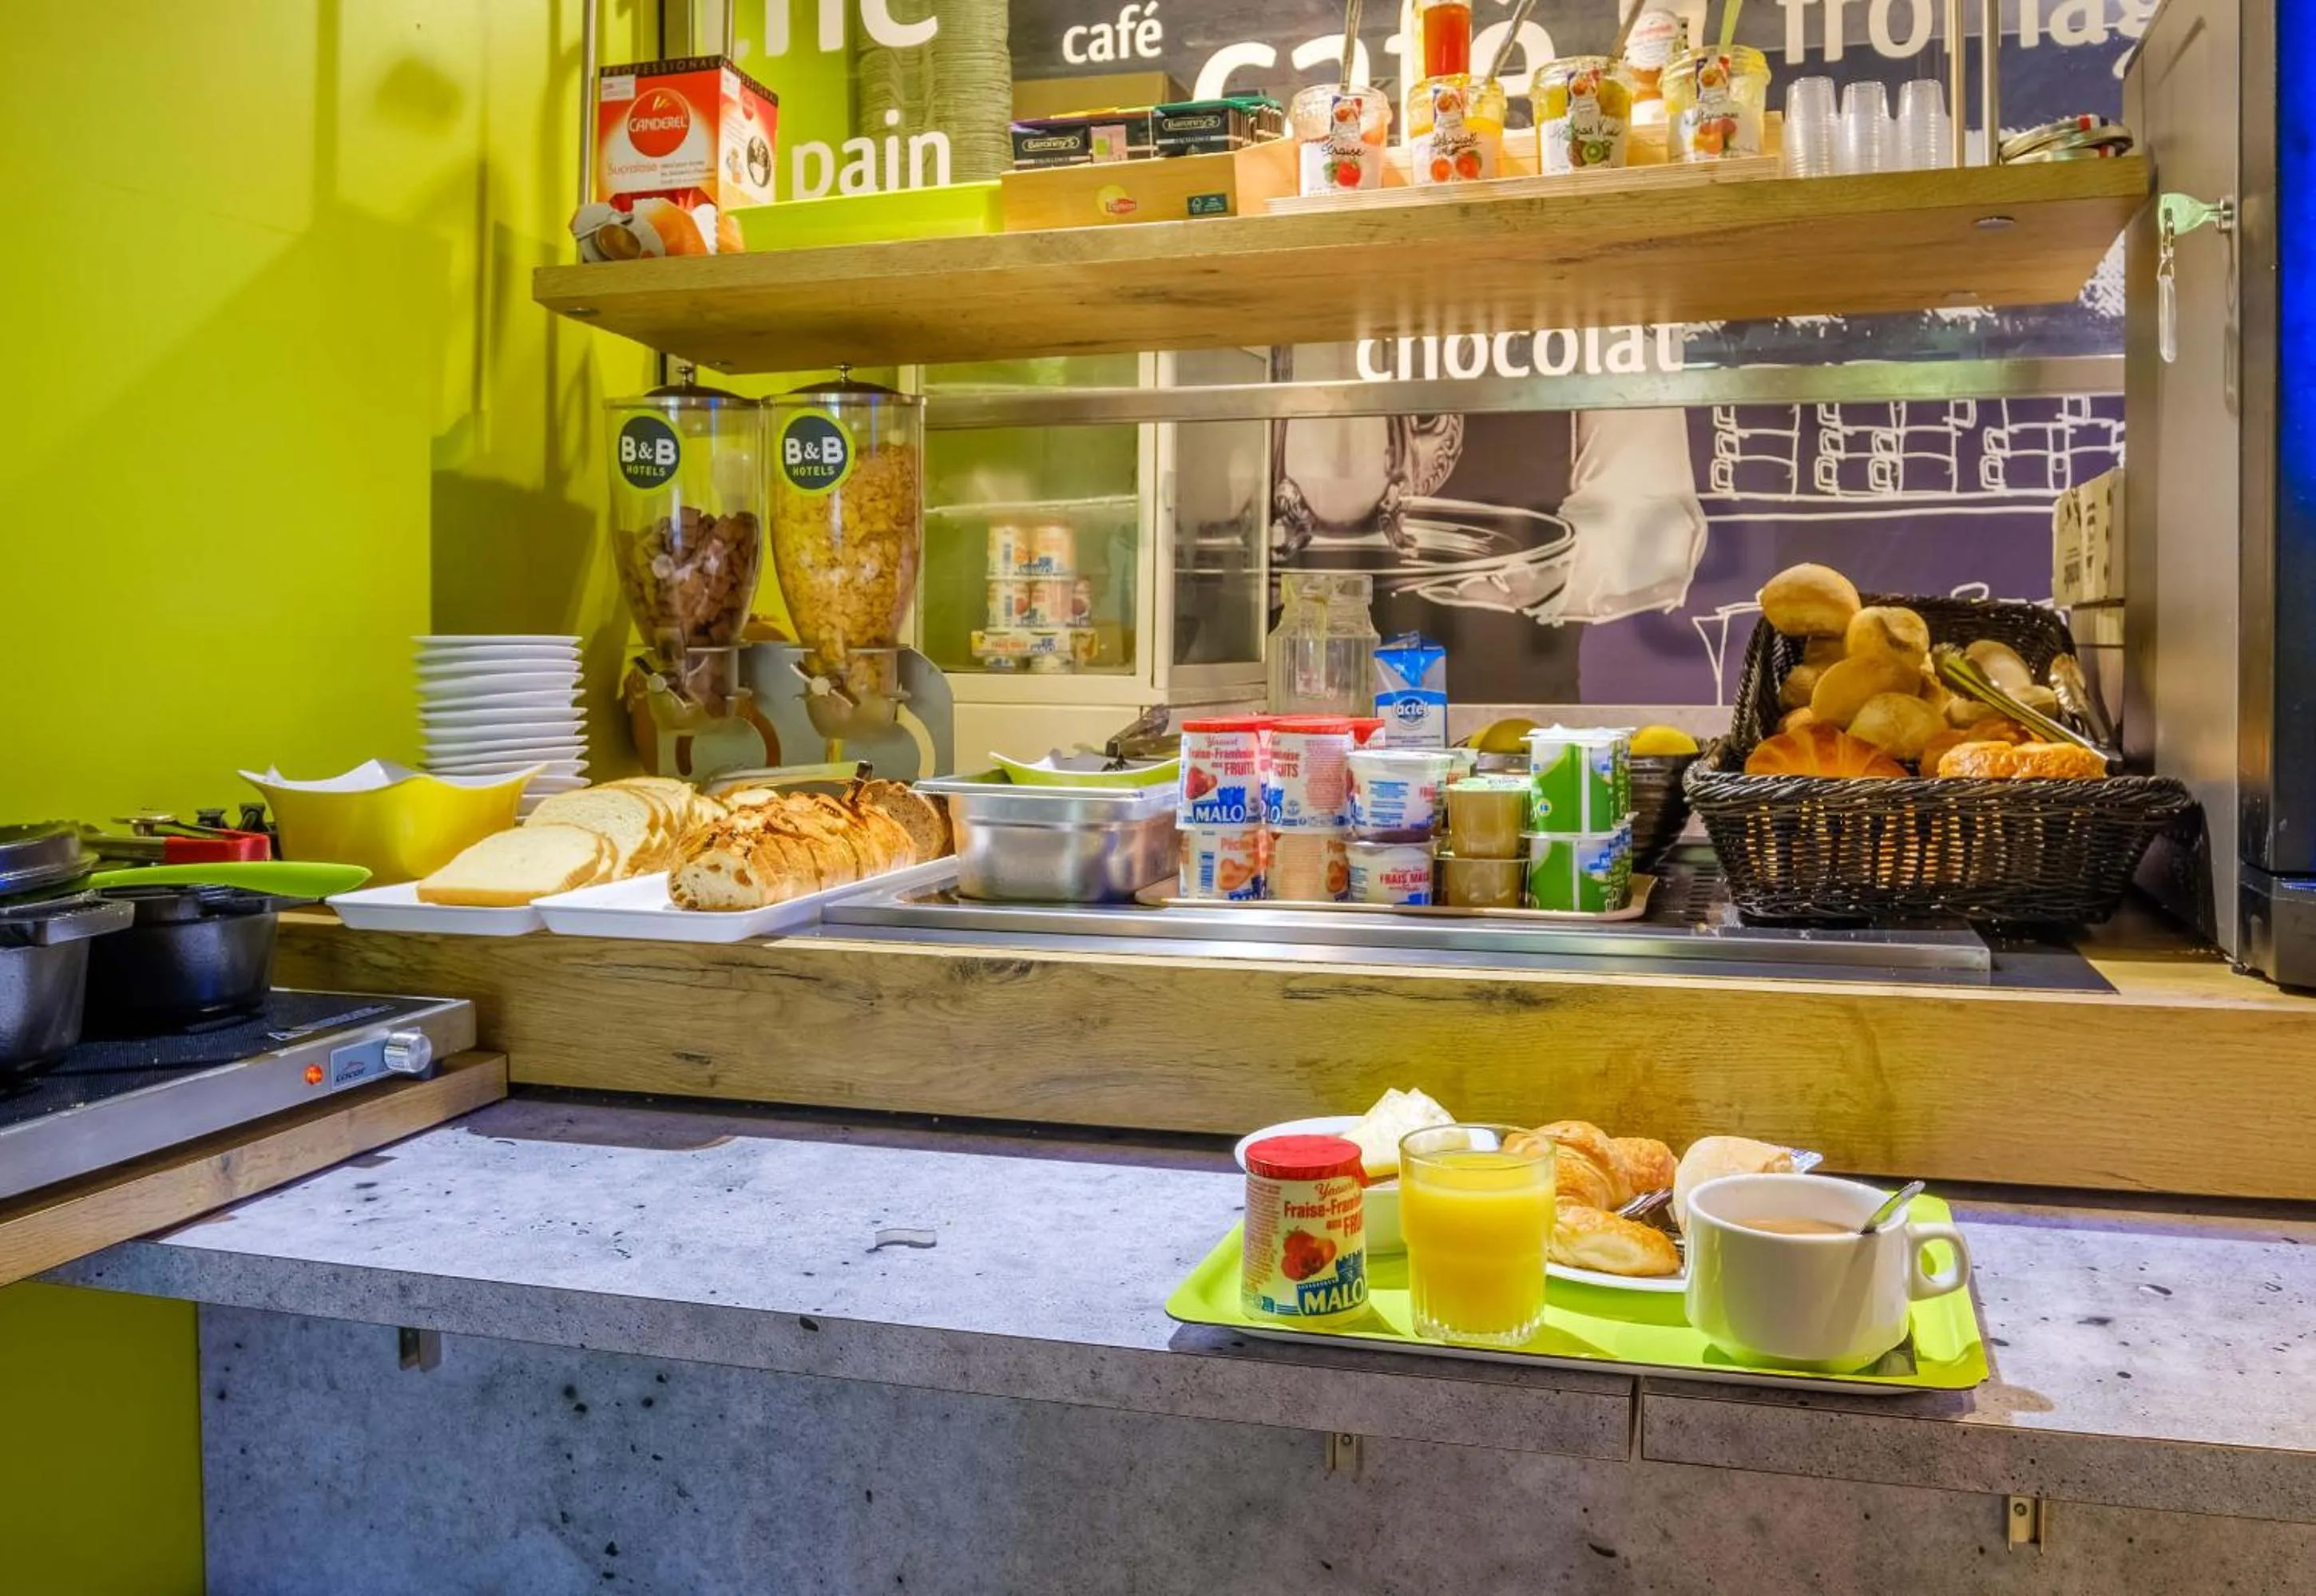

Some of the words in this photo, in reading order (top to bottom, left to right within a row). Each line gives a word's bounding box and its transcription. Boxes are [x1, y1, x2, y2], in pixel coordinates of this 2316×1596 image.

[1062, 1, 1164, 65] café
[628, 117, 688, 133] CANDEREL
[791, 109, 951, 200] pain
[1356, 322, 1684, 382] chocolat
[621, 435, 676, 465] B&B
[785, 436, 844, 465] B&B
[626, 465, 666, 477] HOTELS
[791, 465, 835, 477] HOTELS
[1196, 803, 1245, 823] MALO
[1303, 1277, 1365, 1315] MALO
